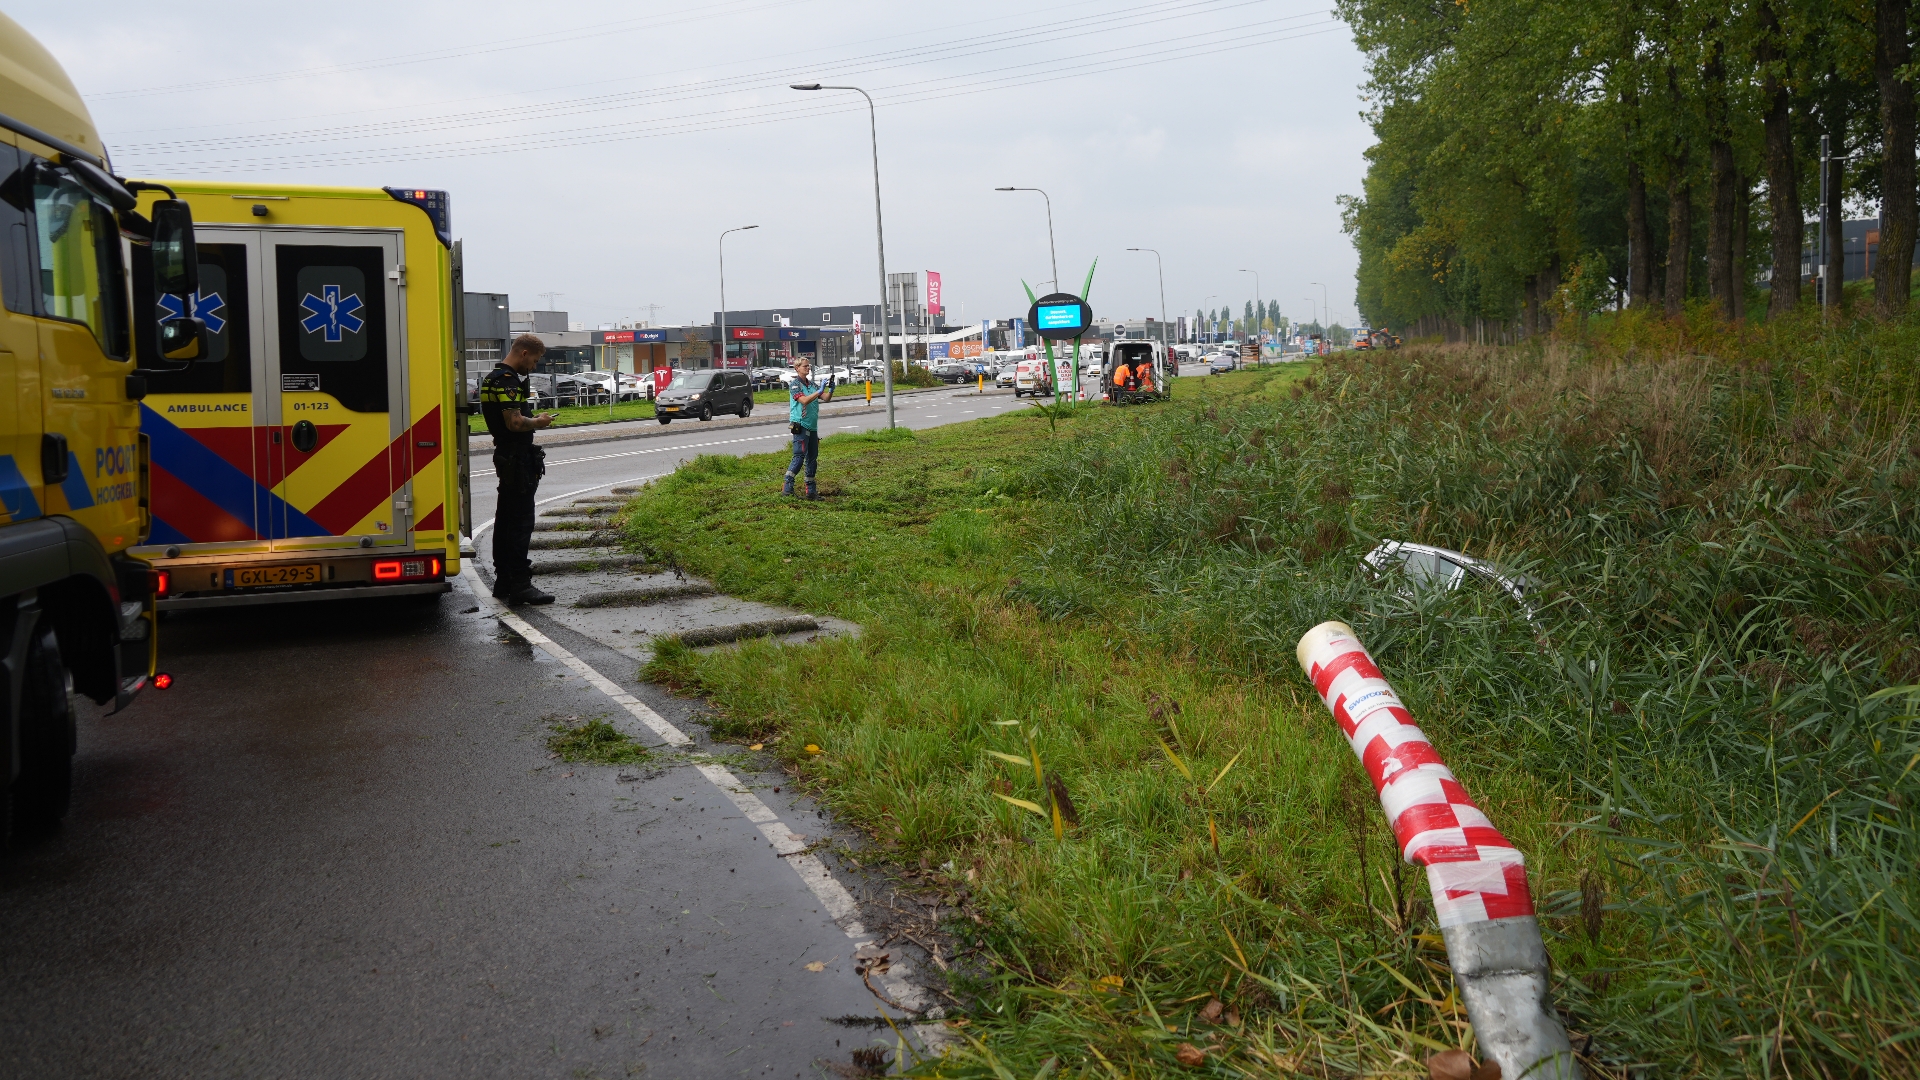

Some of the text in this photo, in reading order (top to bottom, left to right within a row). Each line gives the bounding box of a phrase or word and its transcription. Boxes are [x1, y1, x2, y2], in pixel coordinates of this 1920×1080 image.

[929, 281, 938, 305] AVIS
[167, 403, 248, 413] AMBULANCE
[293, 402, 329, 410] 01-123
[95, 443, 137, 479] POORT
[240, 566, 315, 584] GXL-29-S
[1348, 690, 1382, 711] swarco
